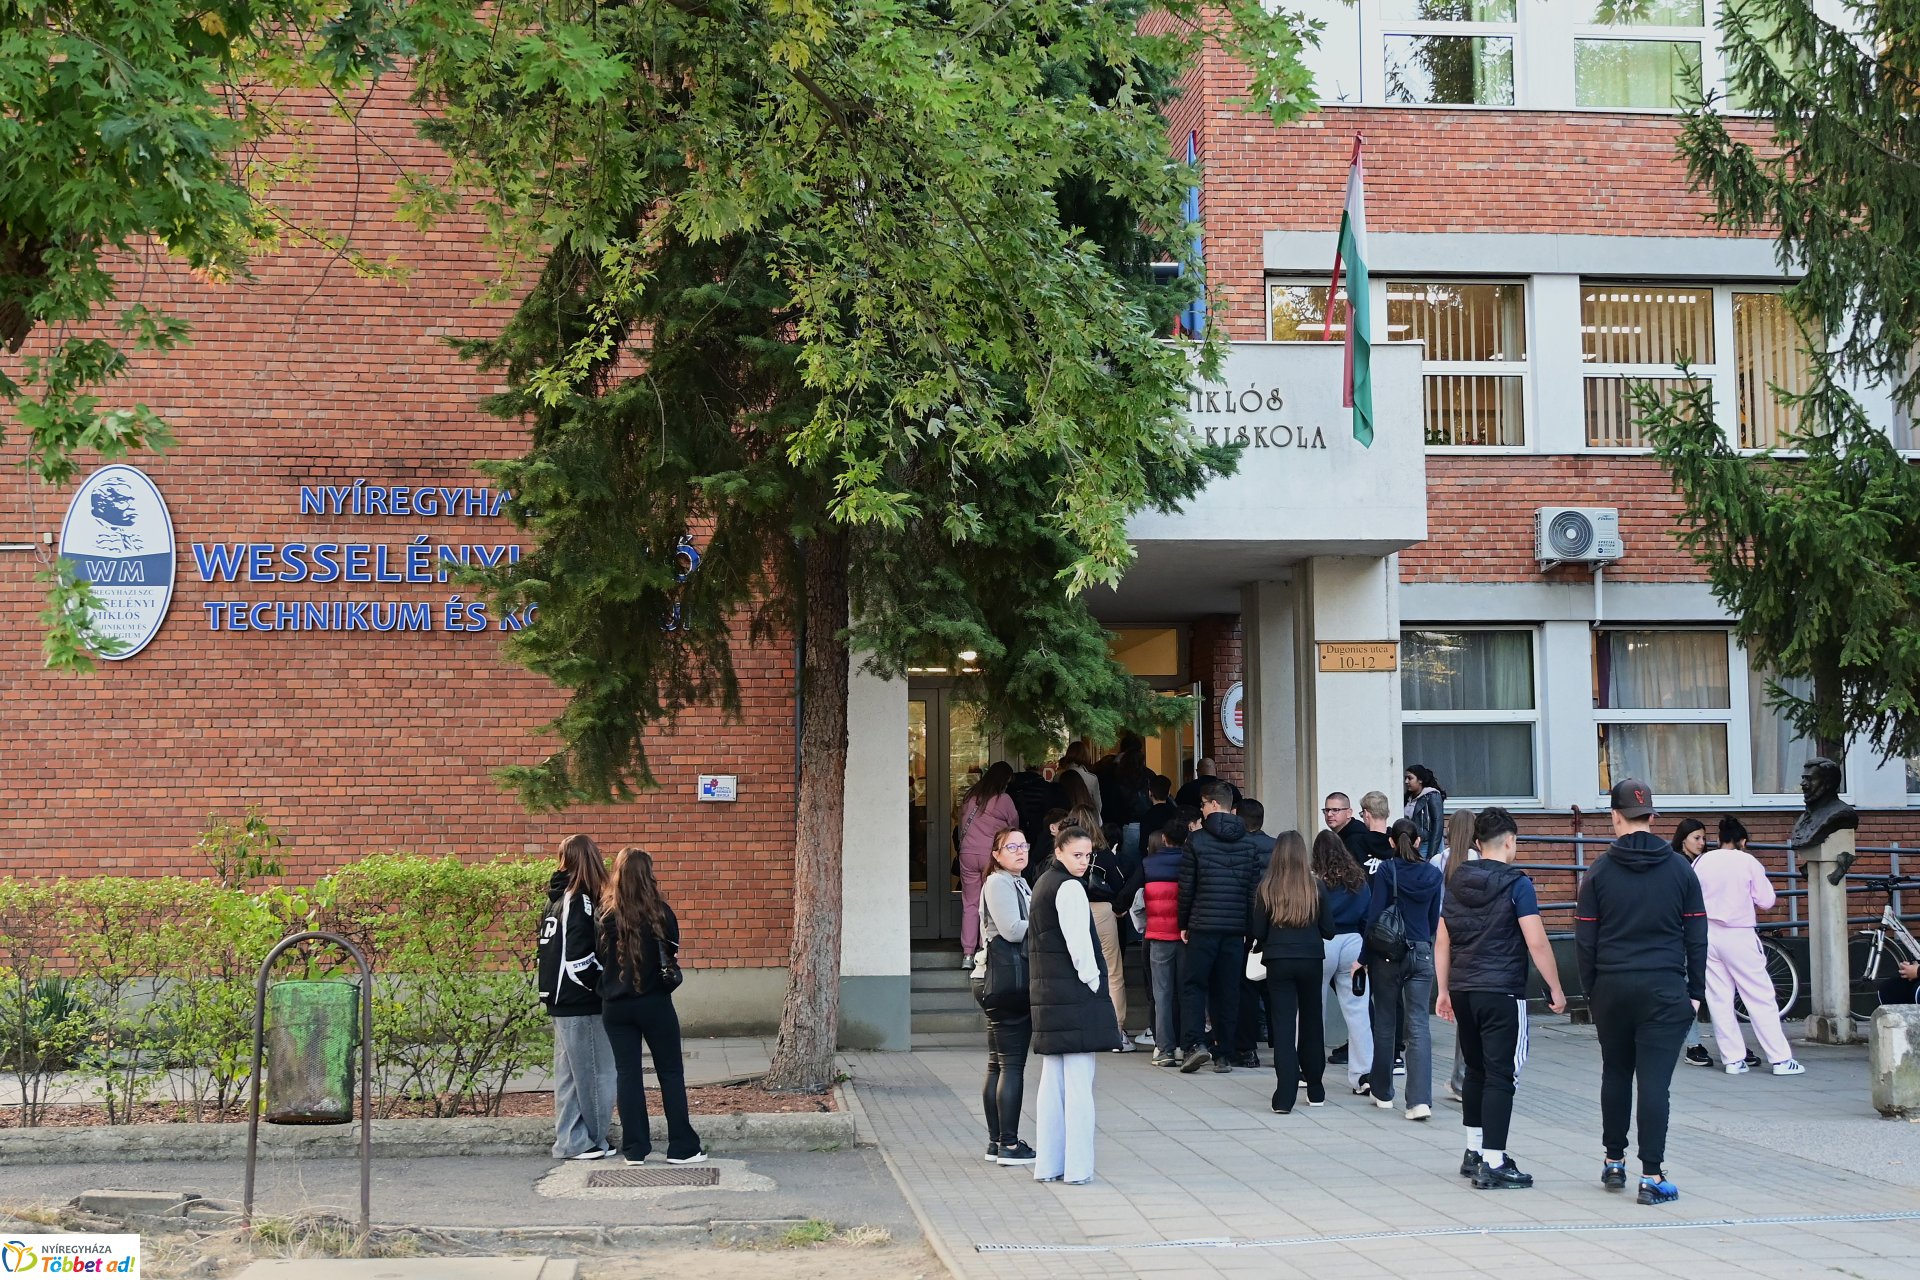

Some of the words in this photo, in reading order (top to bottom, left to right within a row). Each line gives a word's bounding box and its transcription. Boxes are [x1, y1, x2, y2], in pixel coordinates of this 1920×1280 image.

[85, 560, 145, 582] WM
[93, 587, 137, 596] REGYHÁZI
[103, 597, 155, 608] SELÉNYI
[203, 601, 431, 632] TECHNIKUM
[444, 594, 488, 632] ÉS
[1326, 645, 1368, 655] Dugonics
[1340, 656, 1376, 669] 10-12
